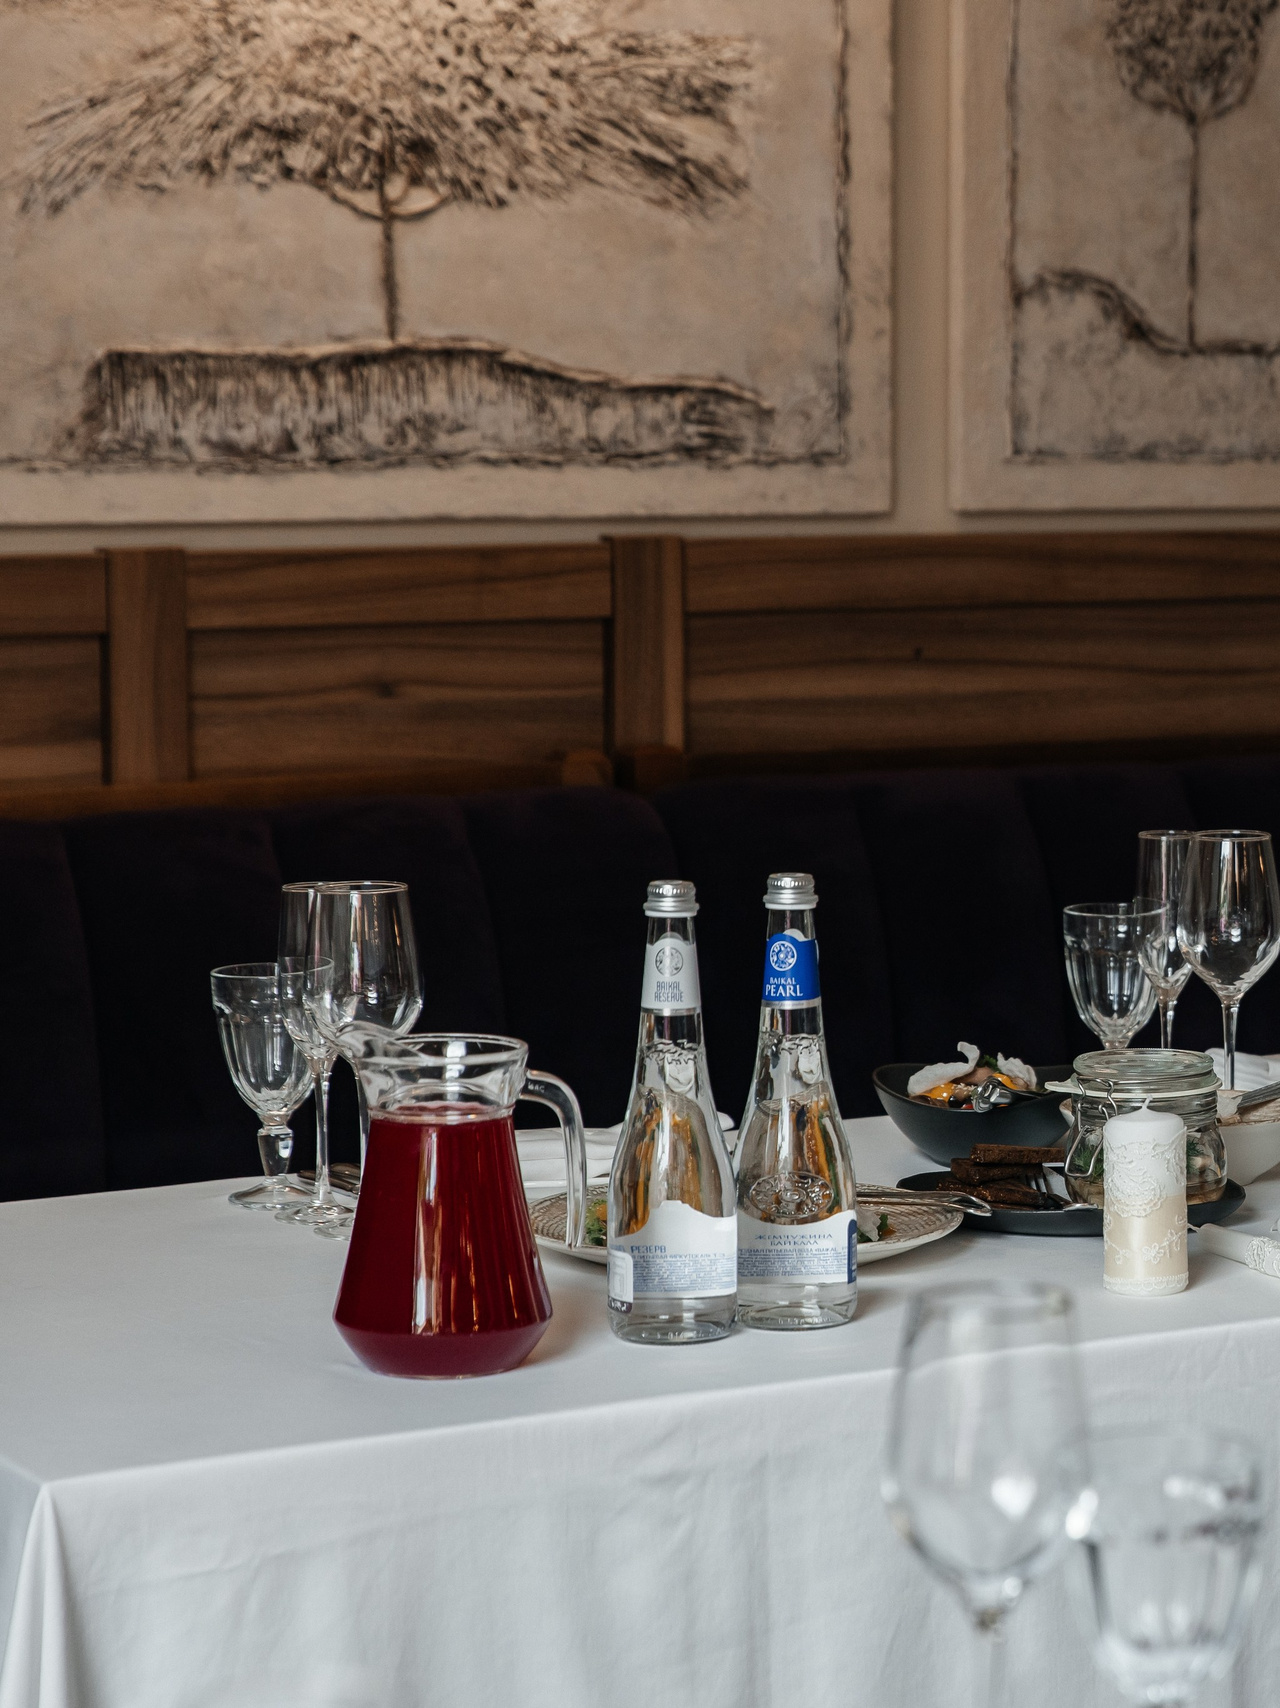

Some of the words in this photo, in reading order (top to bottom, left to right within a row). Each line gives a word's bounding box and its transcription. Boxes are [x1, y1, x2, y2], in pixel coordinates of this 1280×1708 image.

[656, 981, 681, 992] BAIKAL
[769, 977, 796, 985] BAIKAL
[765, 984, 804, 997] PEARL
[654, 991, 684, 1003] RESERVE
[630, 1245, 667, 1254] РЕЗЕРВ
